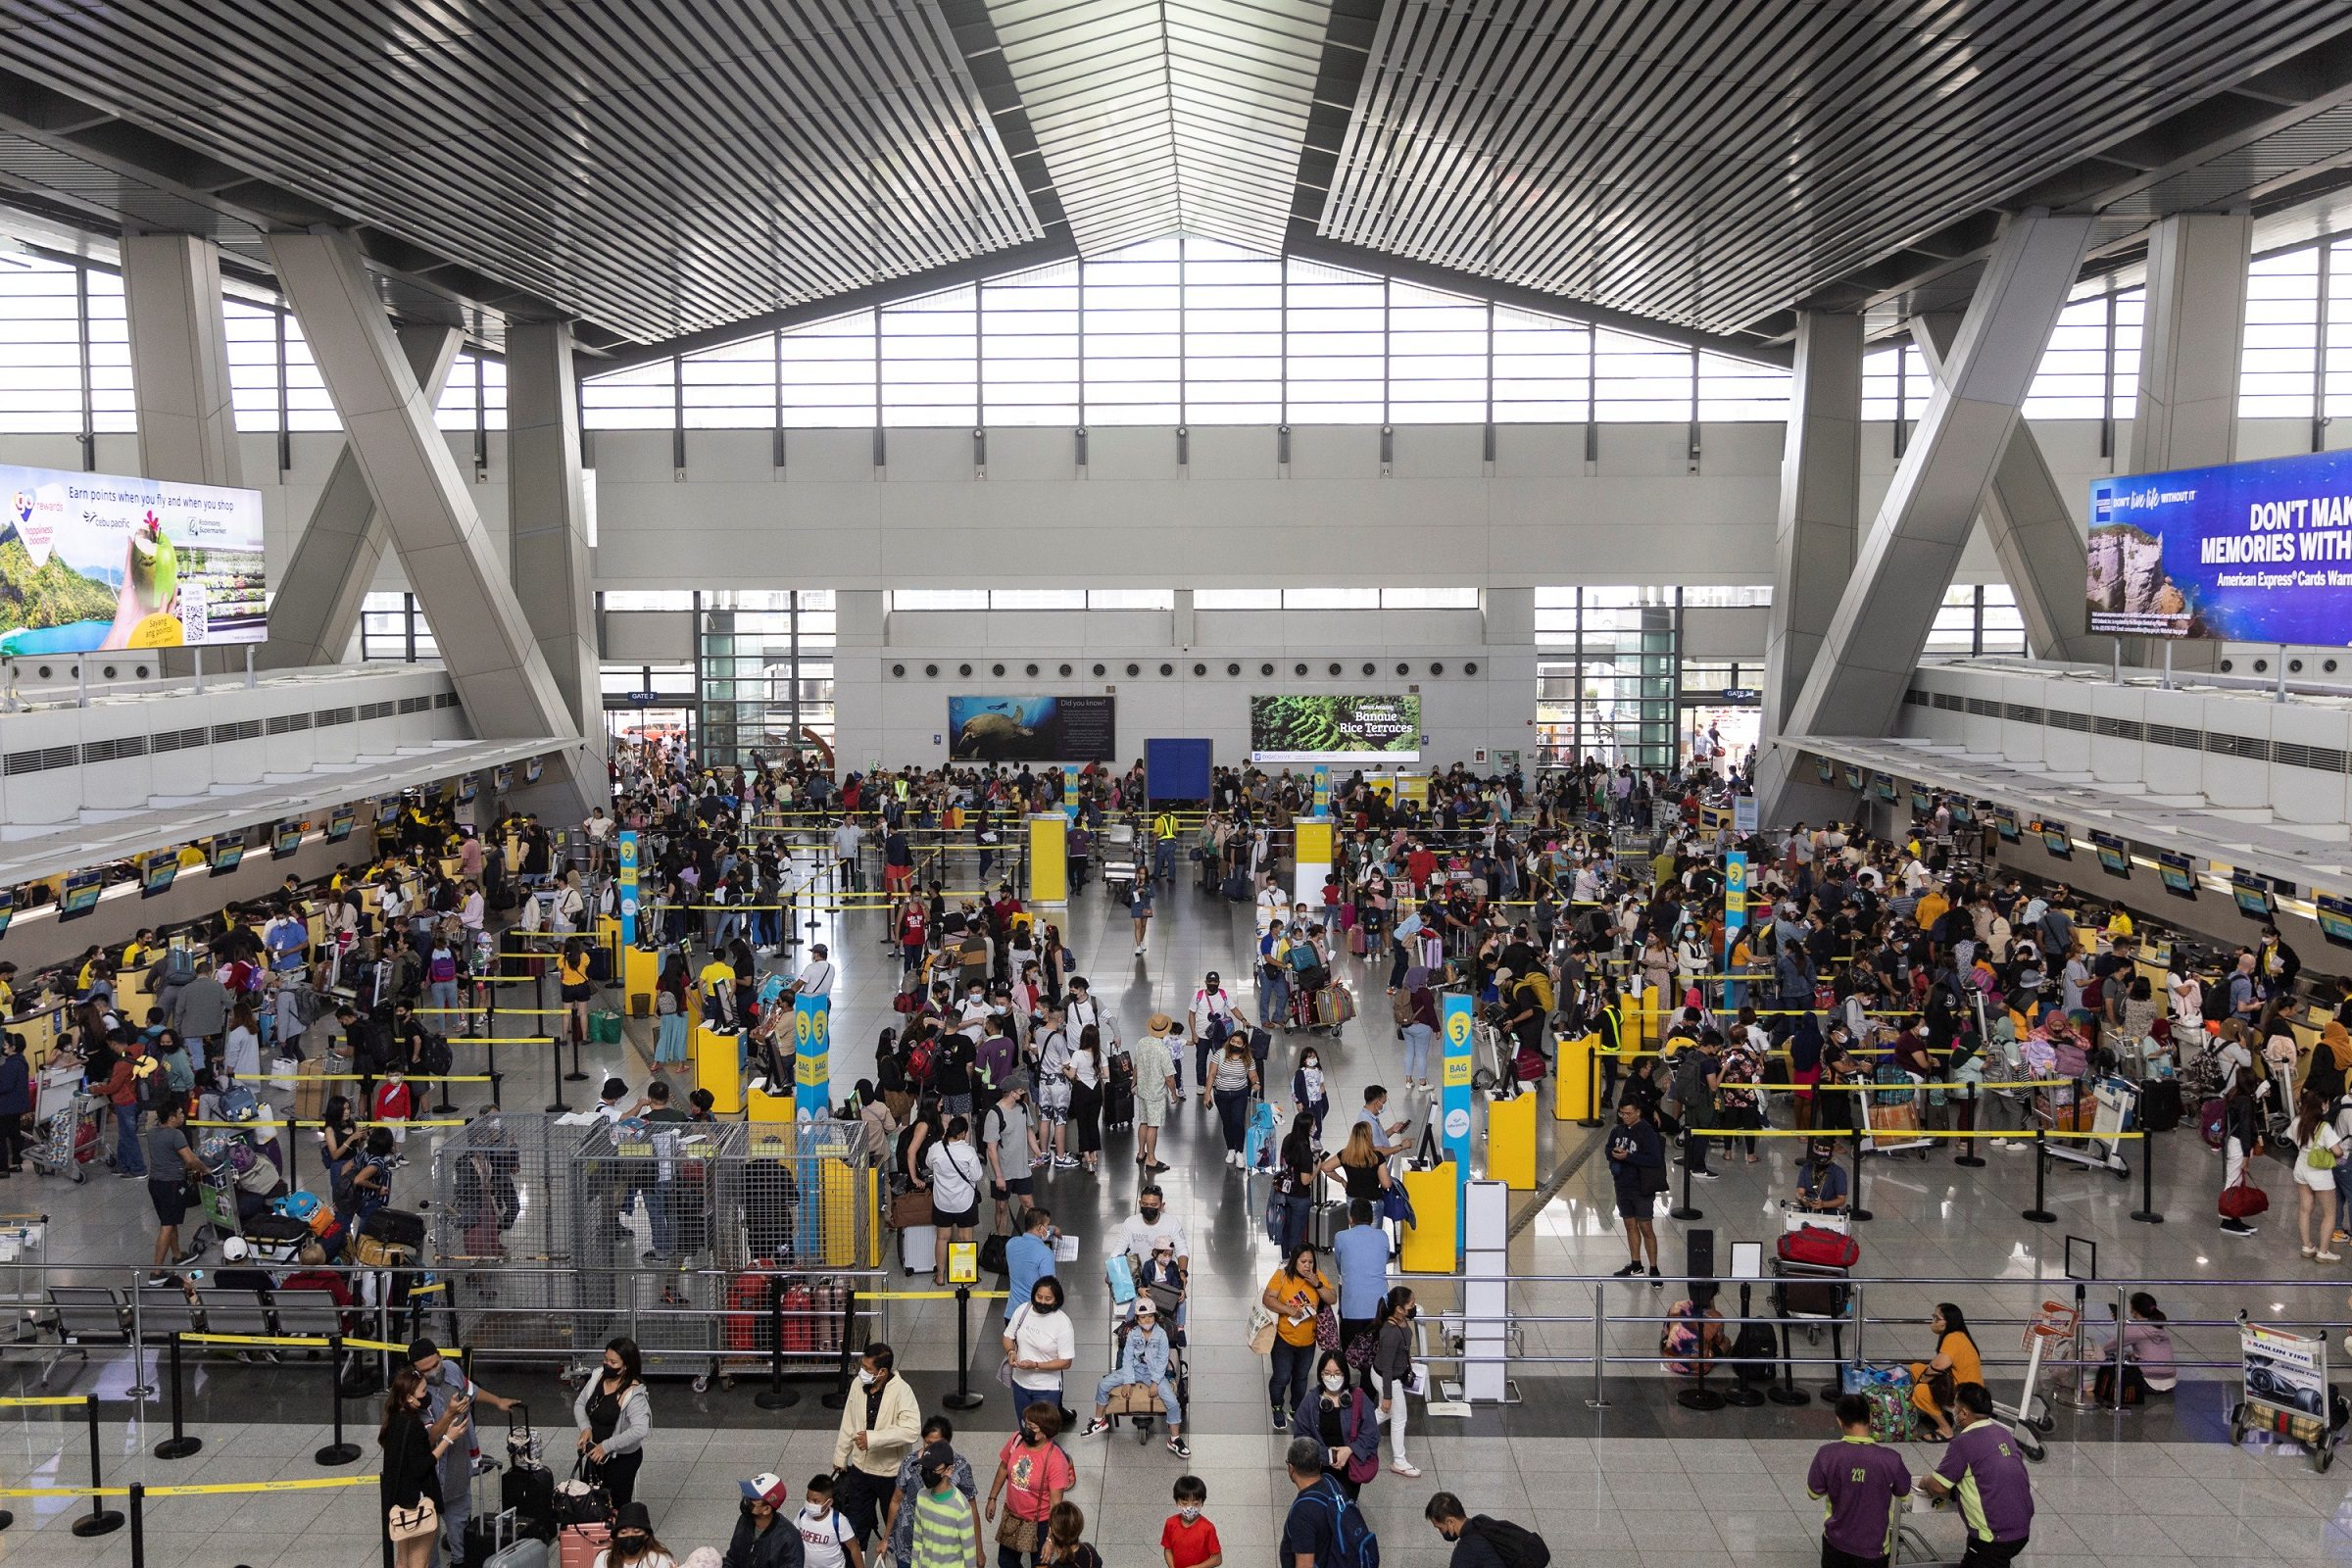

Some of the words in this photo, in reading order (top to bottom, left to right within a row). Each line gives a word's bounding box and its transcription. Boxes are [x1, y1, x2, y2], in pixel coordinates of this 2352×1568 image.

[69, 486, 88, 500] Earn
[91, 489, 117, 503] points
[118, 491, 139, 504] when
[141, 495, 155, 507] you
[157, 494, 166, 508] fly
[168, 495, 181, 507] and
[183, 496, 203, 509] when
[204, 500, 217, 512] you
[218, 499, 234, 513] shop
[2131, 490, 2145, 511] live
[2146, 487, 2160, 511] life
[2161, 491, 2188, 504] WITHOUT
[2188, 490, 2196, 501] IT
[37, 502, 63, 512] rewards
[2249, 499, 2308, 531] DON'T
[95, 518, 111, 528] cebu
[111, 517, 130, 531] pacific
[199, 526, 227, 535] Supermarket
[2201, 532, 2295, 564] MEMORIES
[2299, 530, 2352, 562] WITH
[2217, 572, 2256, 586] American
[2297, 569, 2326, 586] Cards
[1355, 711, 1397, 722] Banaue
[1340, 722, 1363, 733] Rice
[1364, 722, 1413, 733] Terraces
[625, 849, 631, 859] 2
[1732, 871, 1739, 883] 2
[801, 1023, 807, 1041] 3
[816, 1023, 823, 1041] 3
[1454, 1024, 1464, 1042] 3
[798, 1060, 809, 1072] BAG
[814, 1060, 826, 1072] BAG
[1449, 1062, 1467, 1073] BAG
[2252, 1342, 2286, 1356] SAILUN
[2288, 1351, 2310, 1362] TIRE
[2280, 1364, 2305, 1375] SAILUN
[1851, 1468, 1866, 1483] 237
